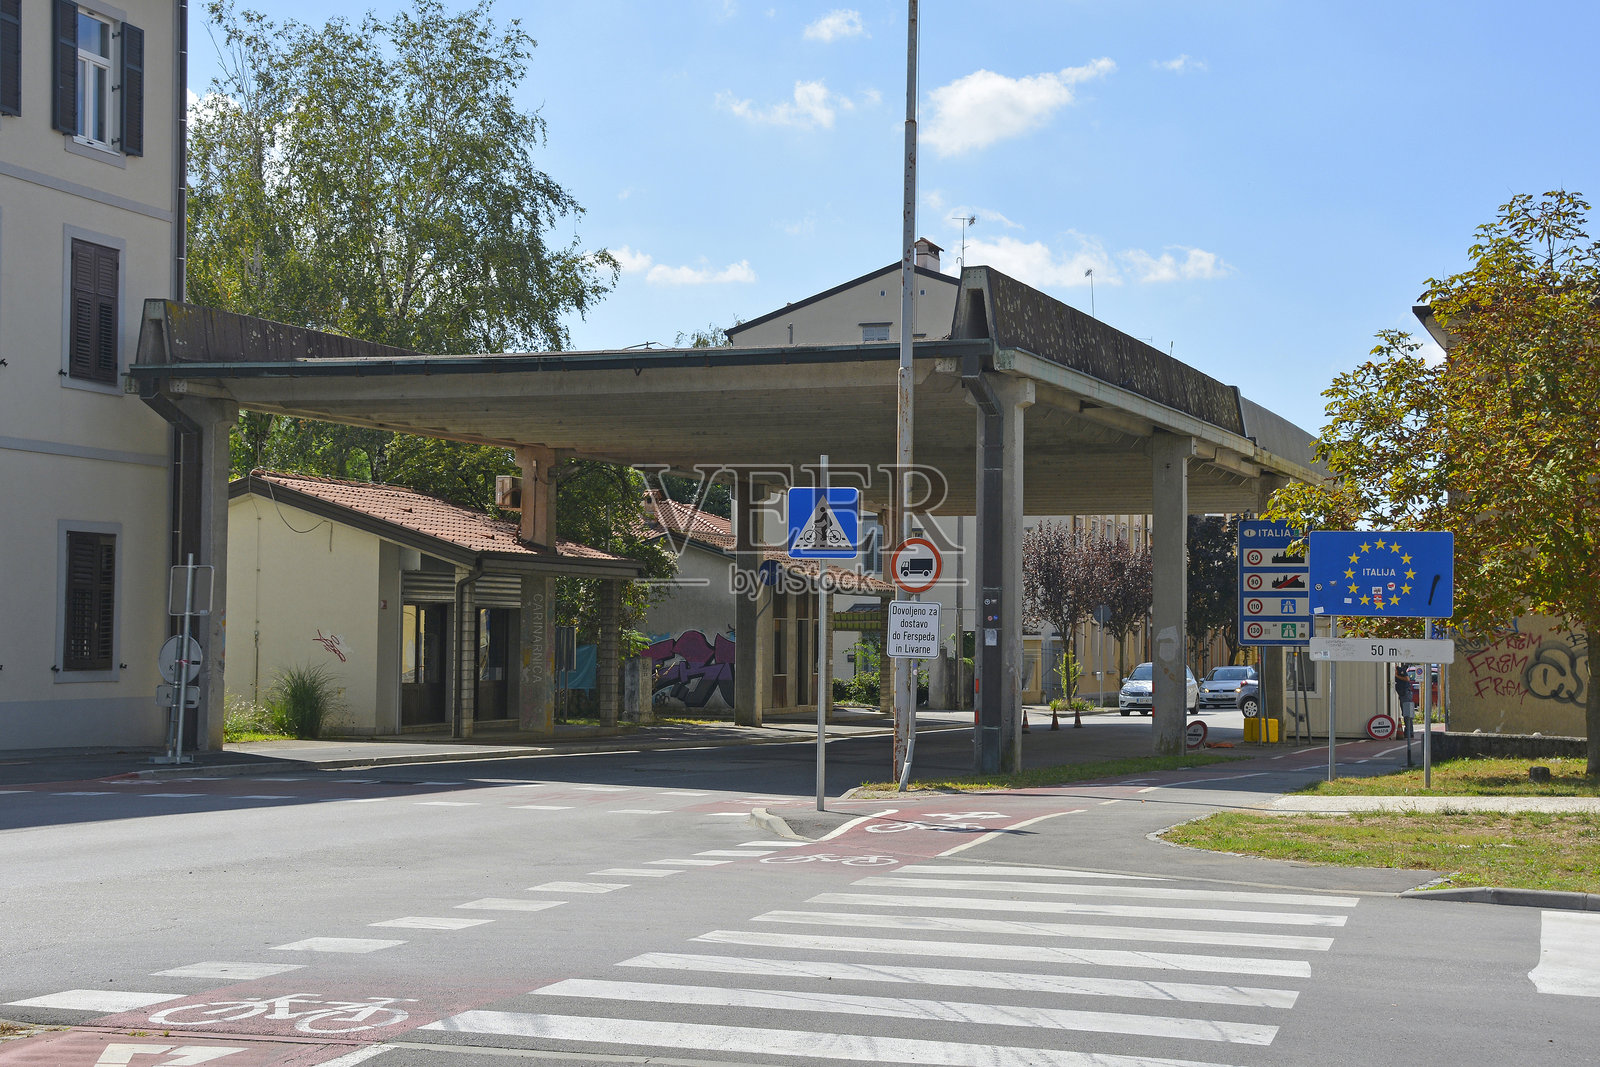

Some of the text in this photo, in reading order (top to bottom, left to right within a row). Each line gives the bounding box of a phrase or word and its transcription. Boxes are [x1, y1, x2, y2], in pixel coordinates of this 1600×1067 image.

[1258, 529, 1291, 537] ITALIA
[1362, 568, 1396, 577] ITALIJA
[892, 605, 938, 617] Dovoljeno za
[900, 619, 928, 628] dostavo
[532, 593, 544, 684] CARINARNICA
[892, 631, 935, 643] do Ferspeda
[895, 644, 931, 654] in Livarne
[1371, 645, 1384, 656] 50
[1388, 647, 1397, 656] m
